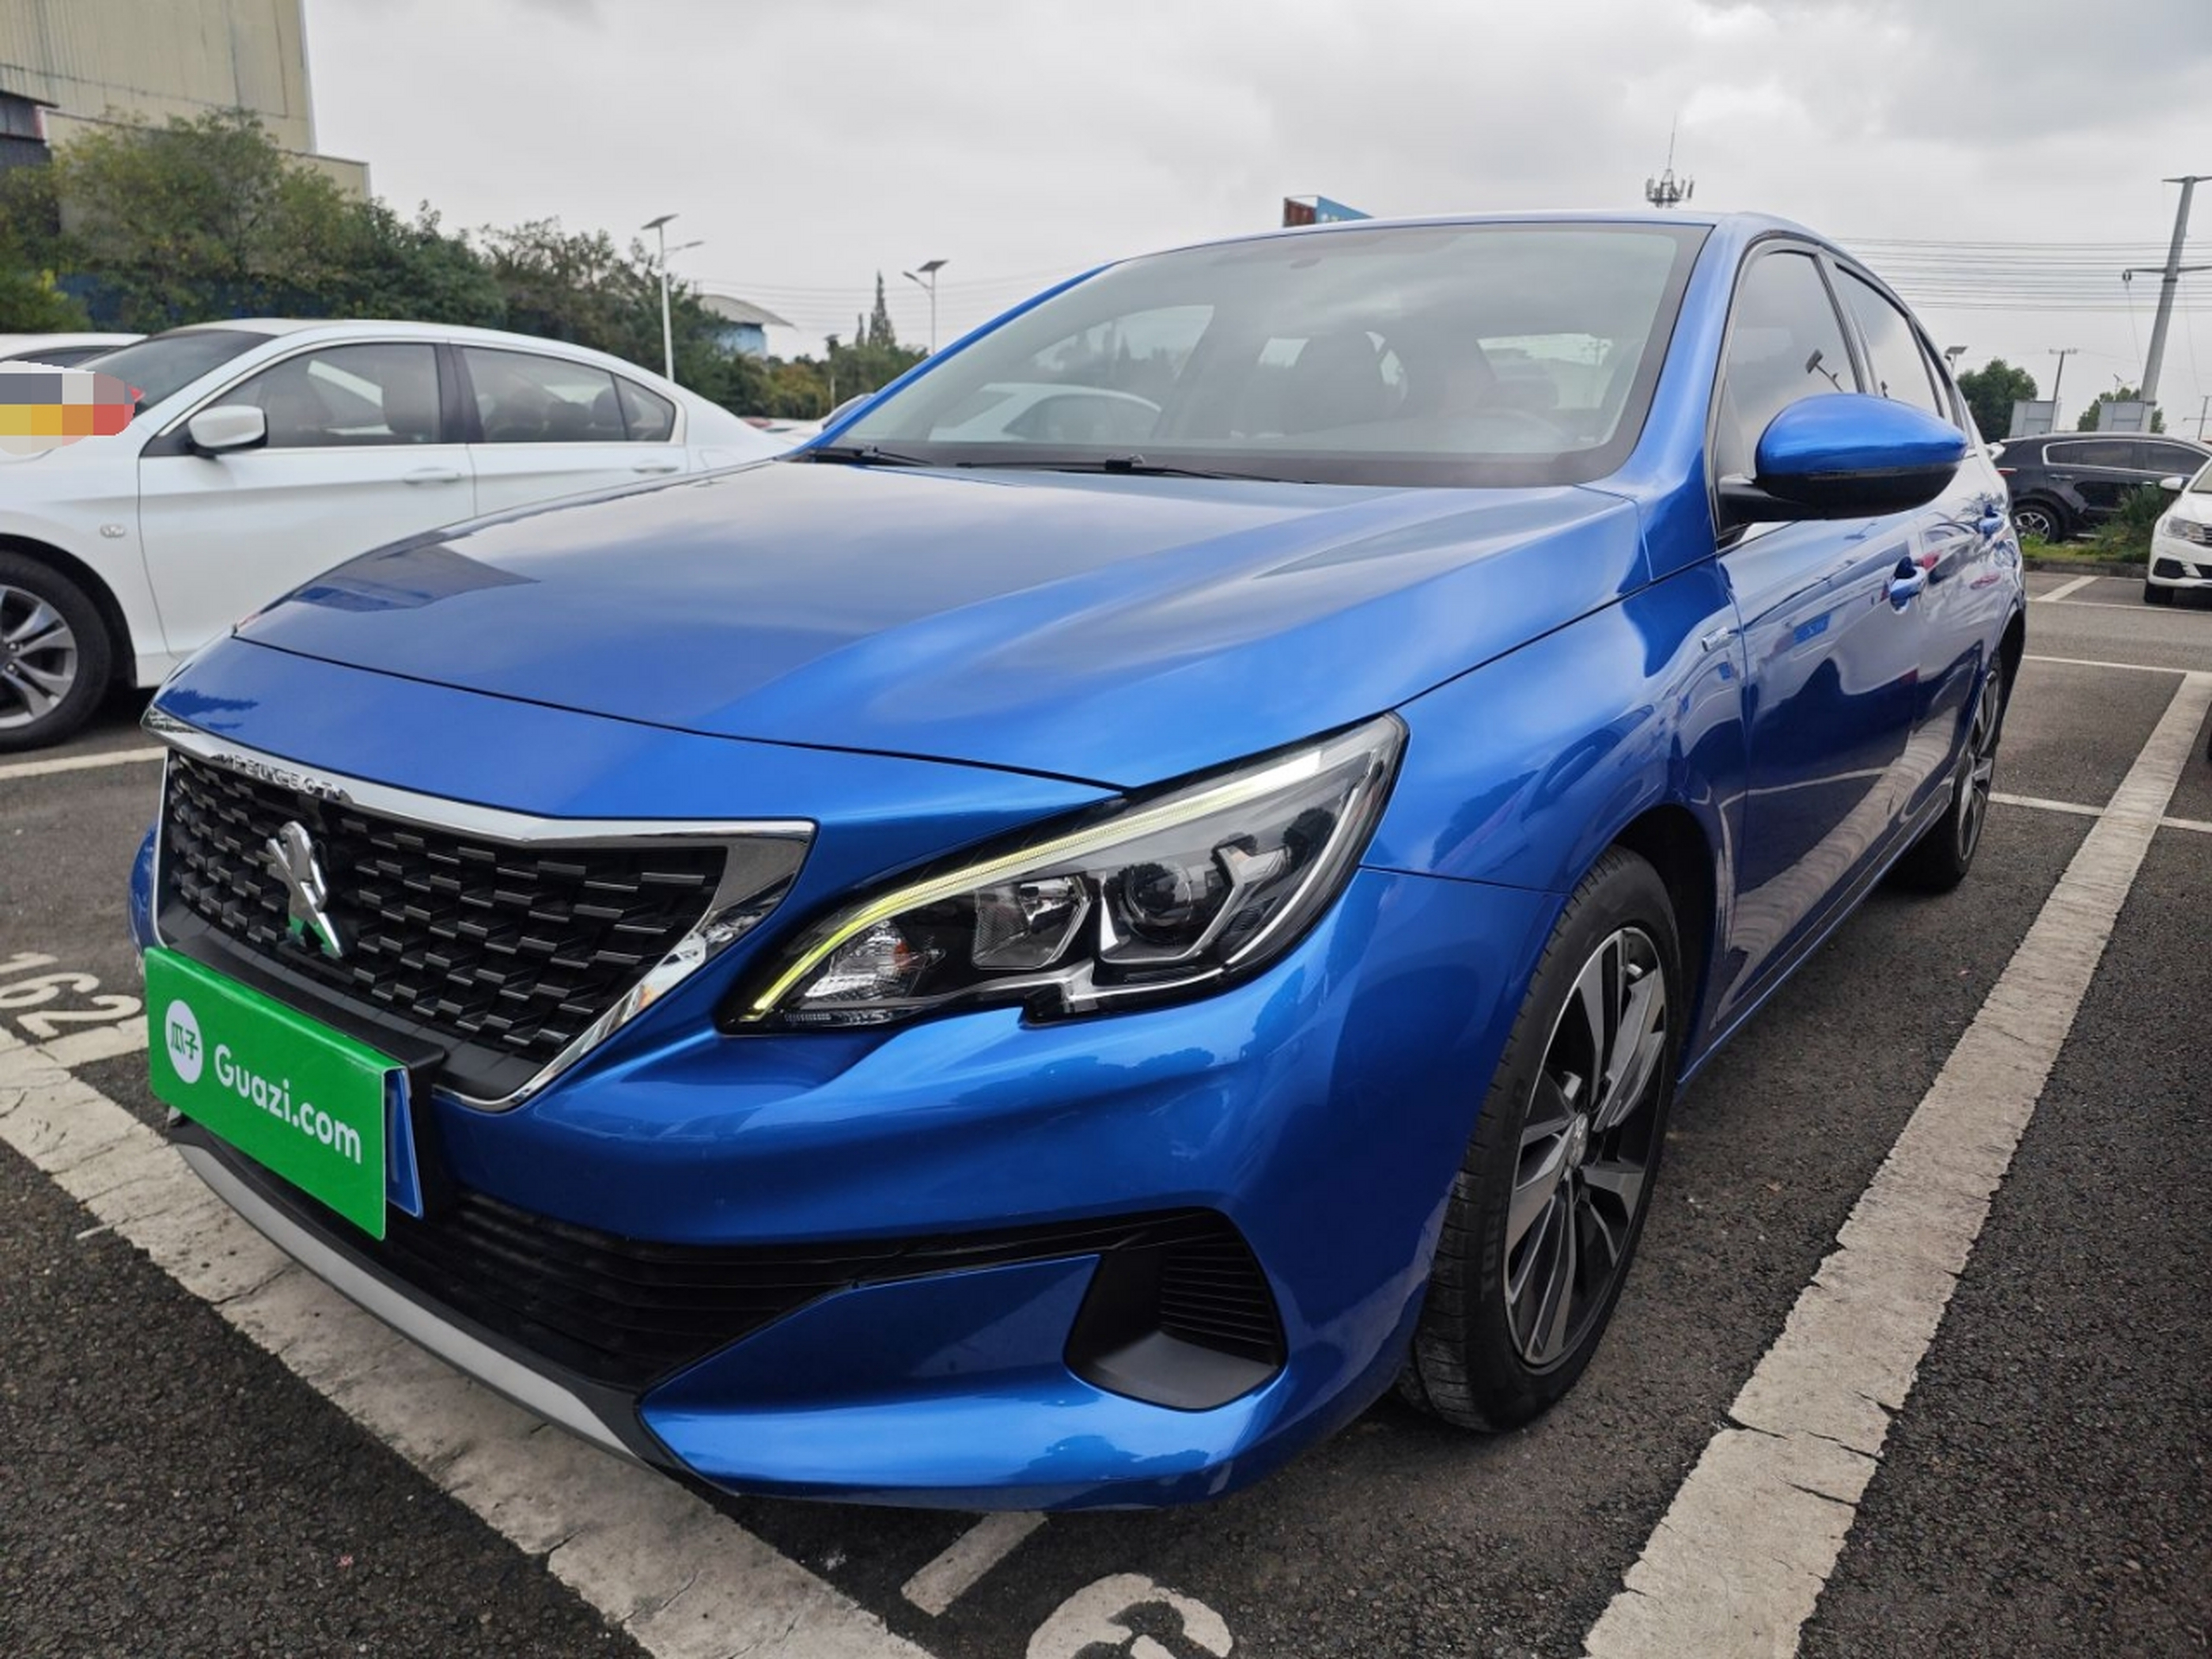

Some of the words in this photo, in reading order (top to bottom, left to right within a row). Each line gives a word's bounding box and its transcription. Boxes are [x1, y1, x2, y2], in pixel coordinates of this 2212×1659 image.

[232, 755, 332, 799] PEUGEOT
[171, 1021, 199, 1060] 瓜子
[214, 1044, 361, 1164] Guazi.com
